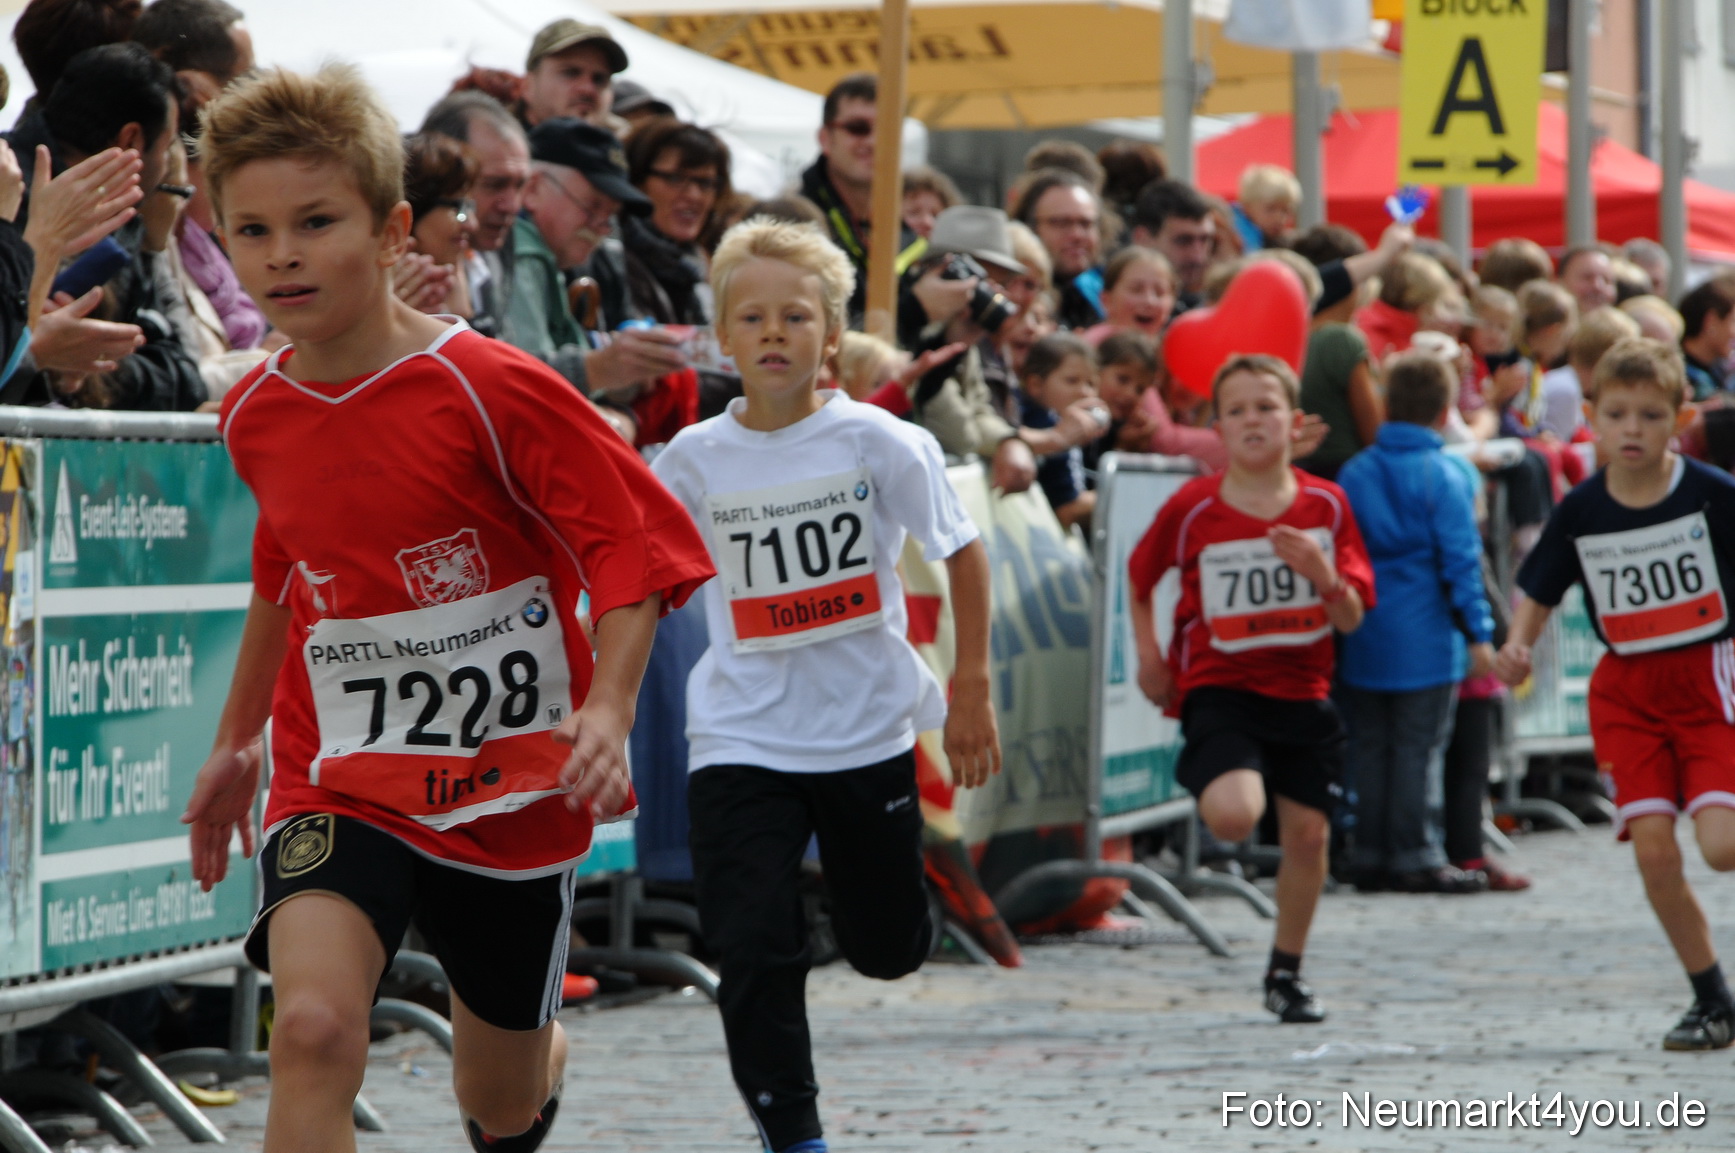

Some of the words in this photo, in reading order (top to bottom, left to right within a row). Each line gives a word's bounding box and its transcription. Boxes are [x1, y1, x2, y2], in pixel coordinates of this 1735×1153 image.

[1431, 36, 1505, 136] A
[80, 493, 188, 551] Event-Leit-Systeme
[712, 507, 760, 525] PARTL
[762, 491, 847, 520] Neumarkt
[729, 512, 868, 588] 7102
[1600, 553, 1703, 609] 7306
[310, 641, 392, 666] PARTL
[399, 614, 516, 659] Neumarkt
[766, 596, 848, 629] Tobias
[50, 638, 101, 718] Mehr
[103, 634, 194, 714] Sicherheit
[342, 650, 539, 749] 7228
[48, 747, 78, 825] für
[81, 744, 109, 821] Ihr
[111, 741, 170, 817] Event!
[48, 898, 75, 946] Miet
[76, 896, 87, 943] &
[88, 890, 127, 941] Service
